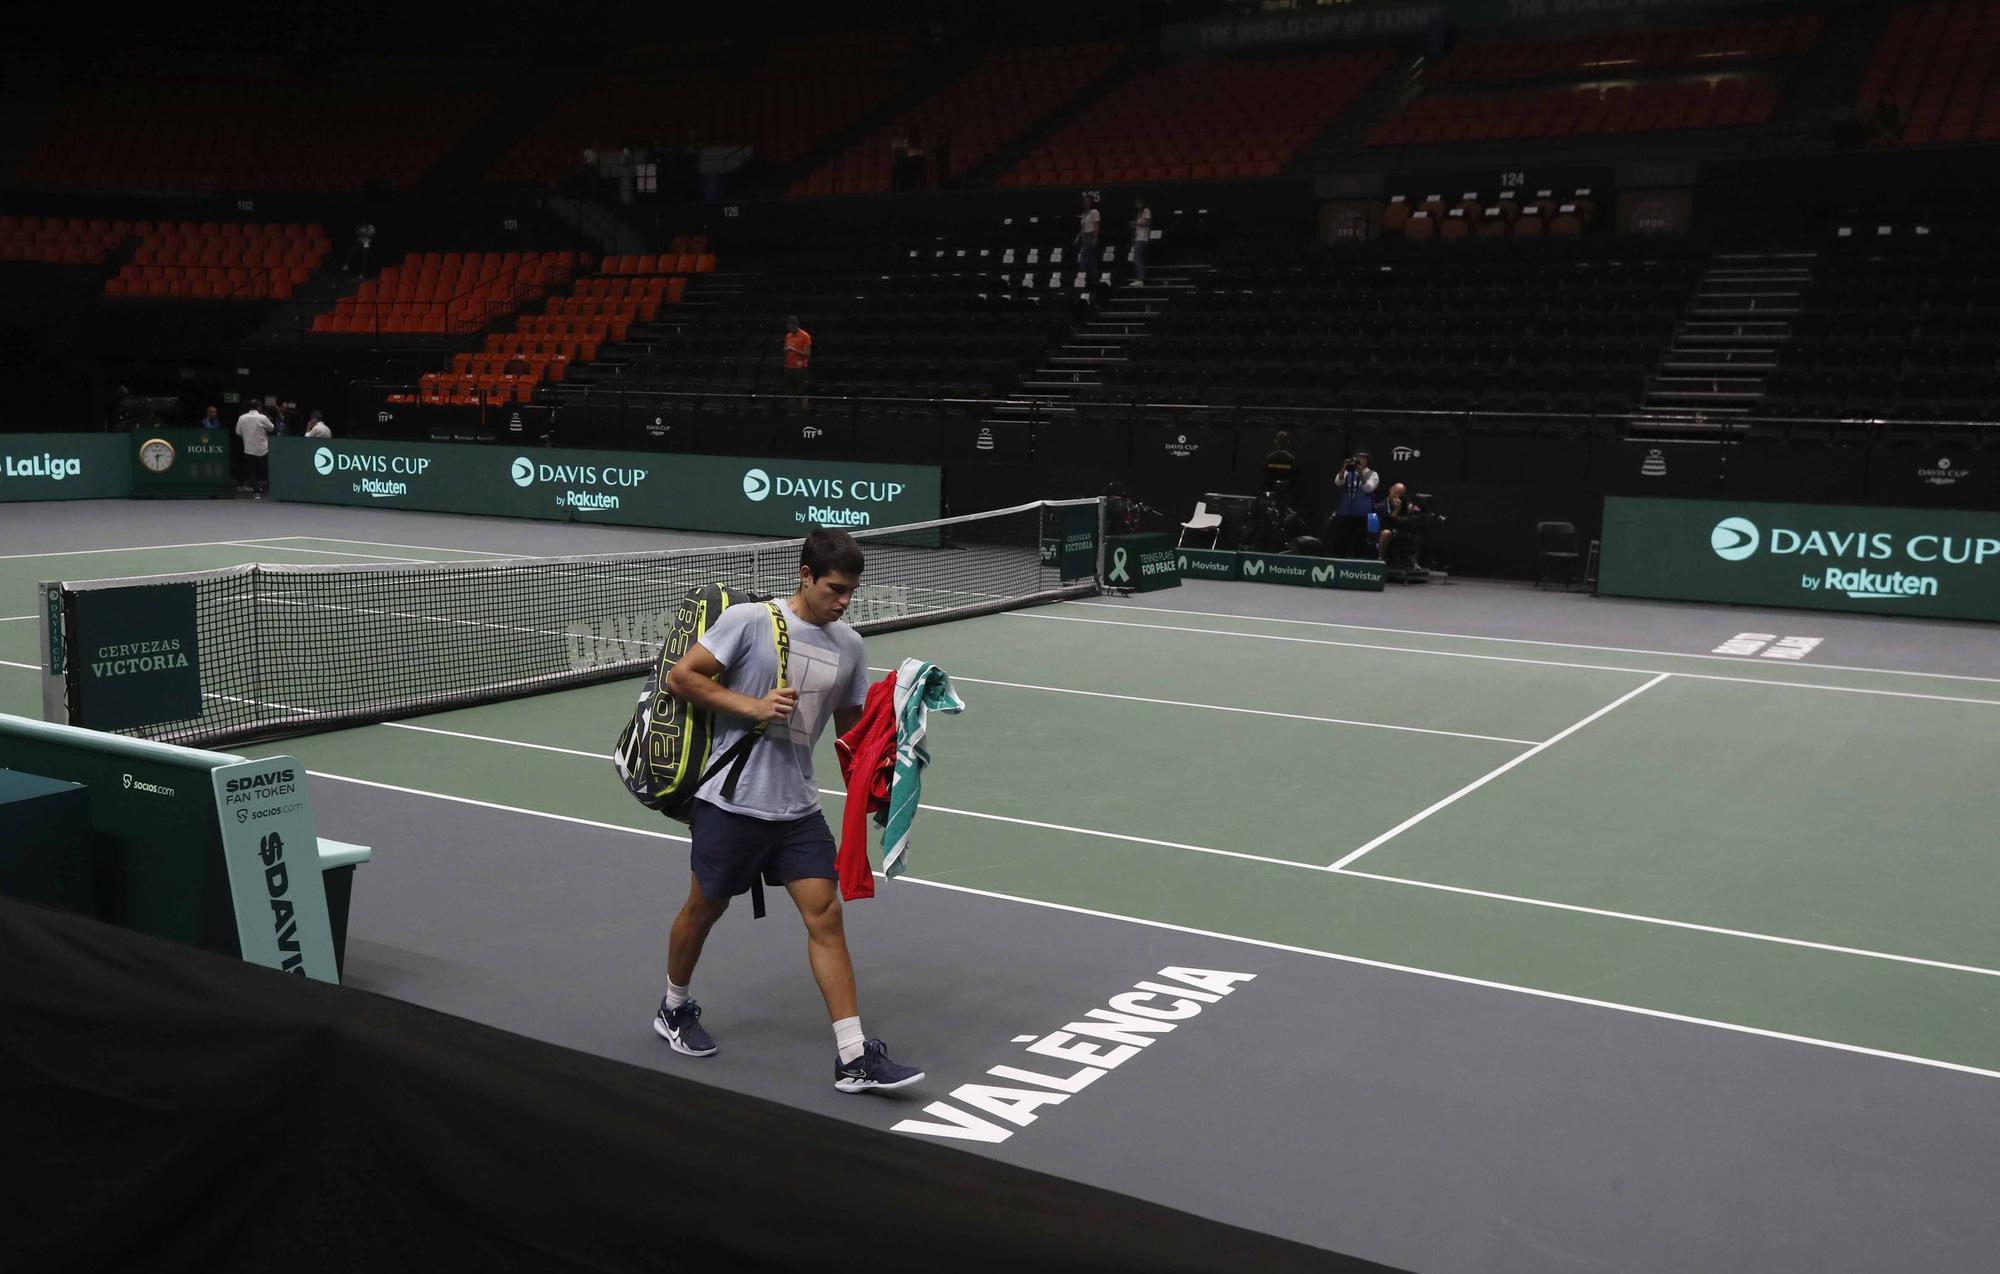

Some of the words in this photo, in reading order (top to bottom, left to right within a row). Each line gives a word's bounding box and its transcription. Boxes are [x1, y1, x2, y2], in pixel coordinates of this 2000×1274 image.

[1200, 26, 1232, 43] THE
[1237, 19, 1299, 41] WORLD
[1304, 16, 1339, 36] CUP
[1500, 171, 1525, 187] 124
[724, 205, 740, 217] 126
[503, 219, 518, 230] 101
[187, 445, 223, 454] ROLEX
[6, 453, 80, 480] LaLiga
[338, 454, 387, 474] DAVIS
[392, 457, 429, 475] CUP
[538, 464, 597, 486] DAVIS
[603, 467, 646, 488] CUP
[352, 483, 361, 493] by
[362, 478, 407, 496] Rakuten
[776, 476, 844, 499] DAVIS
[850, 481, 903, 502] CUP
[556, 496, 566, 507] by
[567, 490, 620, 510] Rakuten
[795, 511, 807, 522] by
[808, 505, 870, 527] Rakuten
[1065, 541, 1093, 552] VICTORIA
[1770, 528, 1893, 560] DAVIS
[1906, 535, 2000, 564] CUP
[1142, 563, 1156, 575] FOR
[1156, 560, 1176, 572] PEACE
[1191, 560, 1230, 572] Movistar
[1268, 565, 1307, 576] Movistar
[1339, 569, 1382, 582] Movistar
[1801, 574, 1821, 591] by
[1824, 567, 1939, 597] Rakuten
[51, 604, 59, 644] DAVIS
[98, 638, 181, 659] CERVEZAS
[91, 652, 190, 678] VICTORIA
[226, 792, 251, 805] FAN
[254, 784, 295, 799] TOKEN
[258, 832, 307, 978] $DAVI
[889, 966, 1258, 1143] VALÈNCIA
